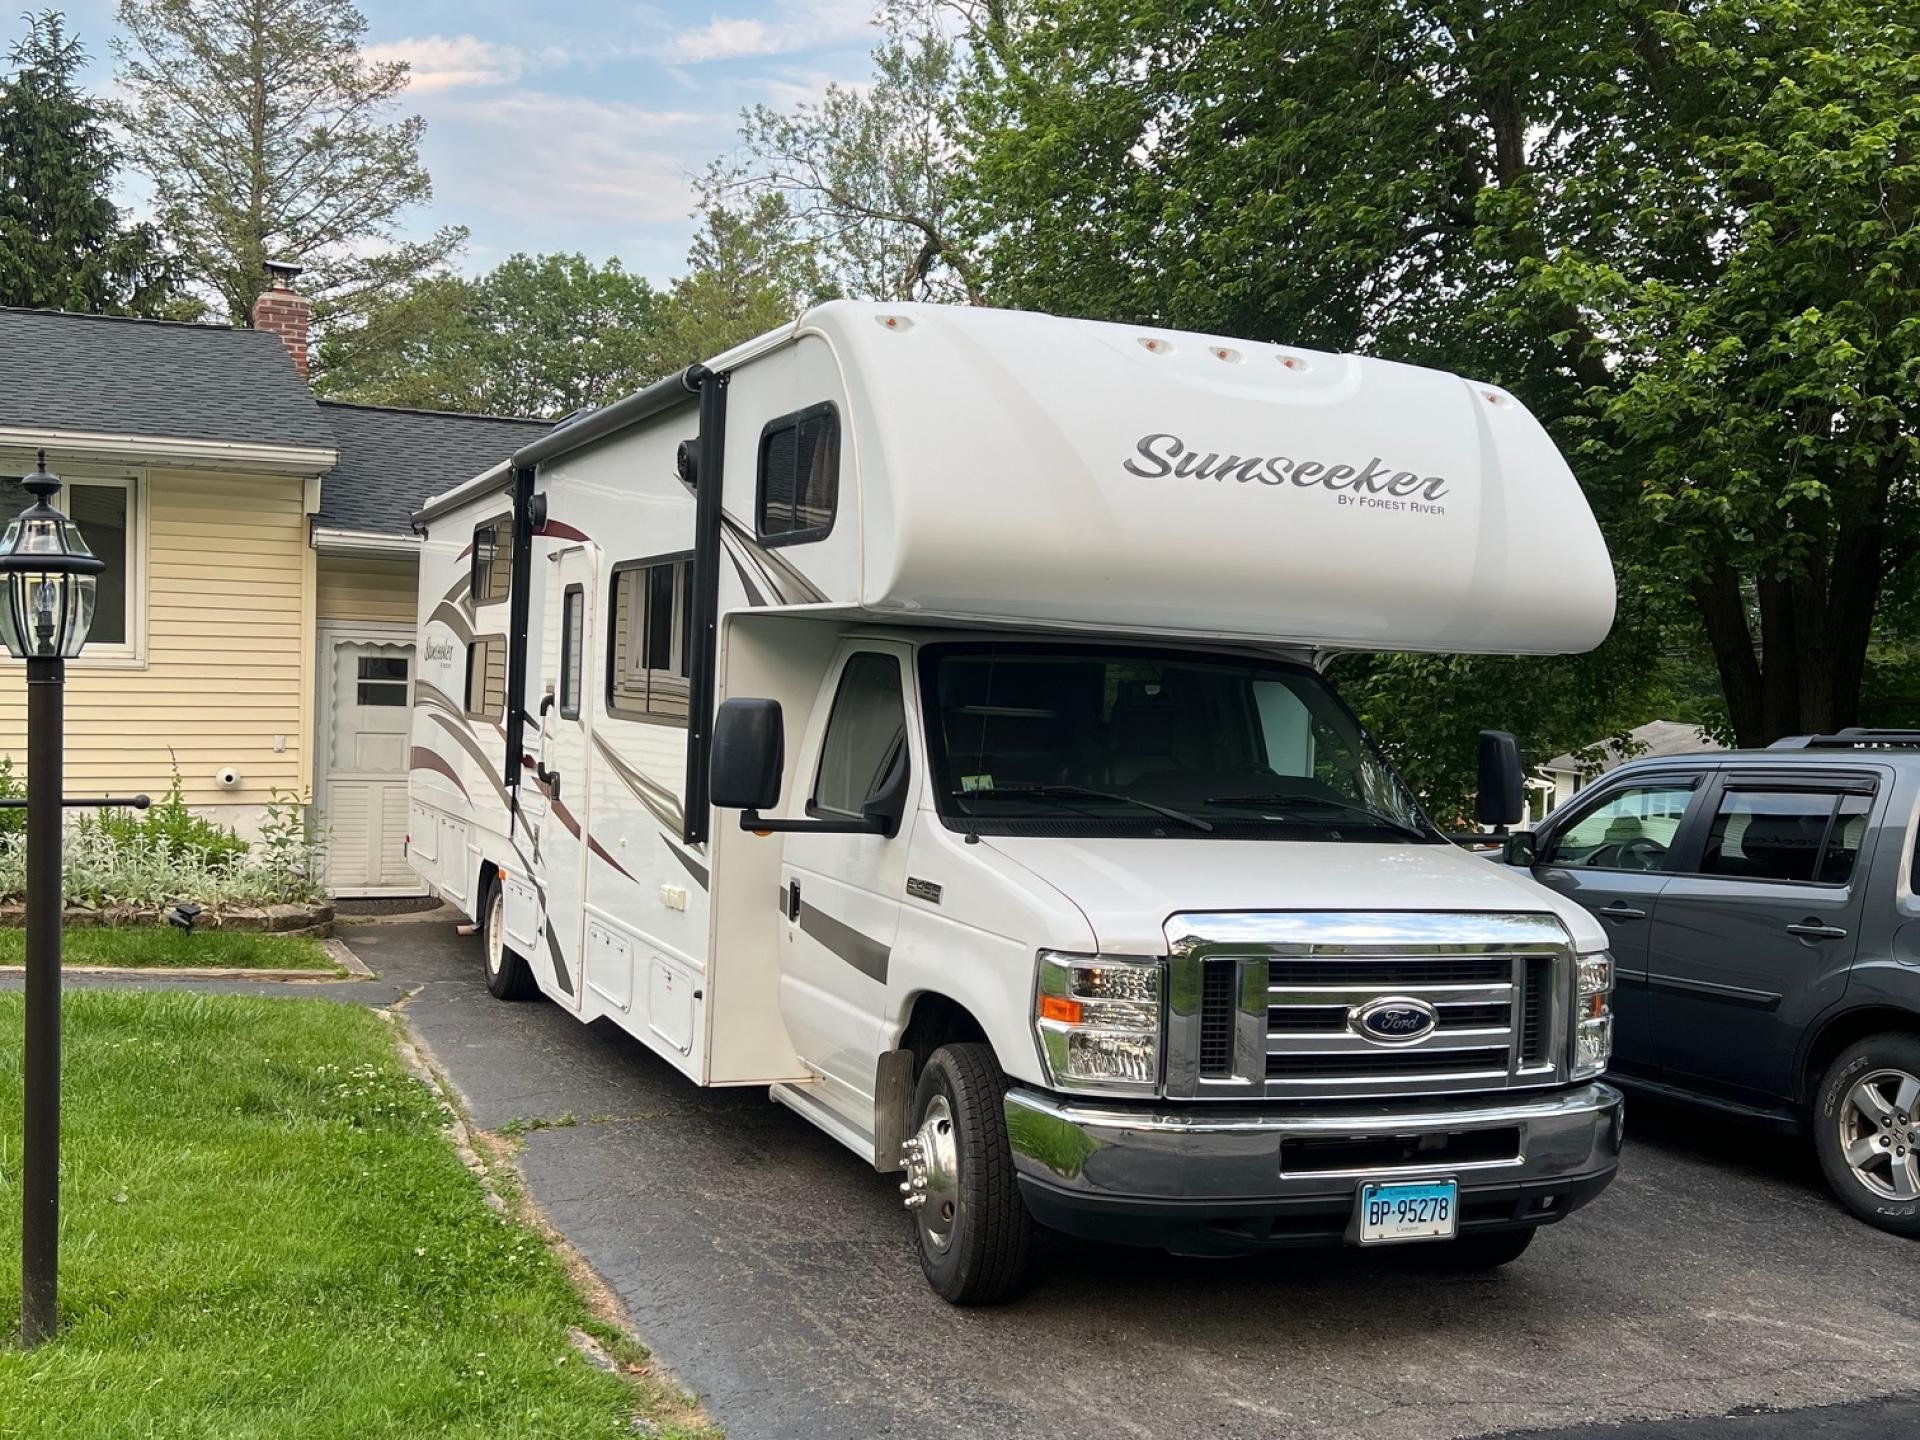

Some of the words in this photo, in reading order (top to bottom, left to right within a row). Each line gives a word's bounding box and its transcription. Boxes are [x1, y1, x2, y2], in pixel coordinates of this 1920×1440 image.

[1123, 433, 1449, 501] Sunseeker
[1337, 494, 1356, 506] BY
[1359, 496, 1406, 511] FOREST
[1410, 501, 1445, 516] RIVER
[1381, 1009, 1420, 1029] Ford
[1824, 1056, 1869, 1119] COOPER
